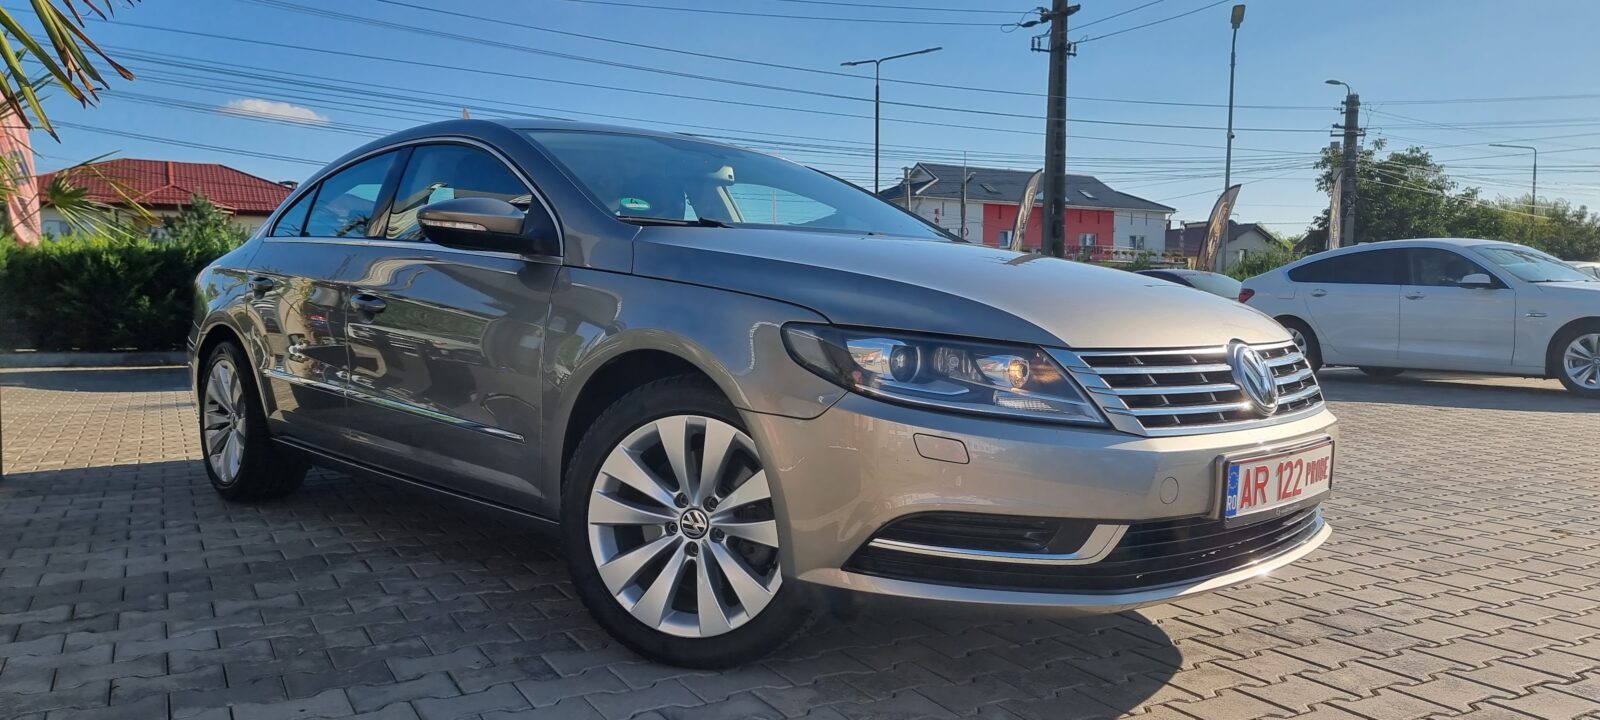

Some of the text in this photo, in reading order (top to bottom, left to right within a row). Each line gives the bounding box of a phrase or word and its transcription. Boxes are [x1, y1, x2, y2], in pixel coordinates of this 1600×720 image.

[1240, 466, 1270, 509] AR
[1276, 458, 1304, 501] 122
[1226, 495, 1238, 512] RO
